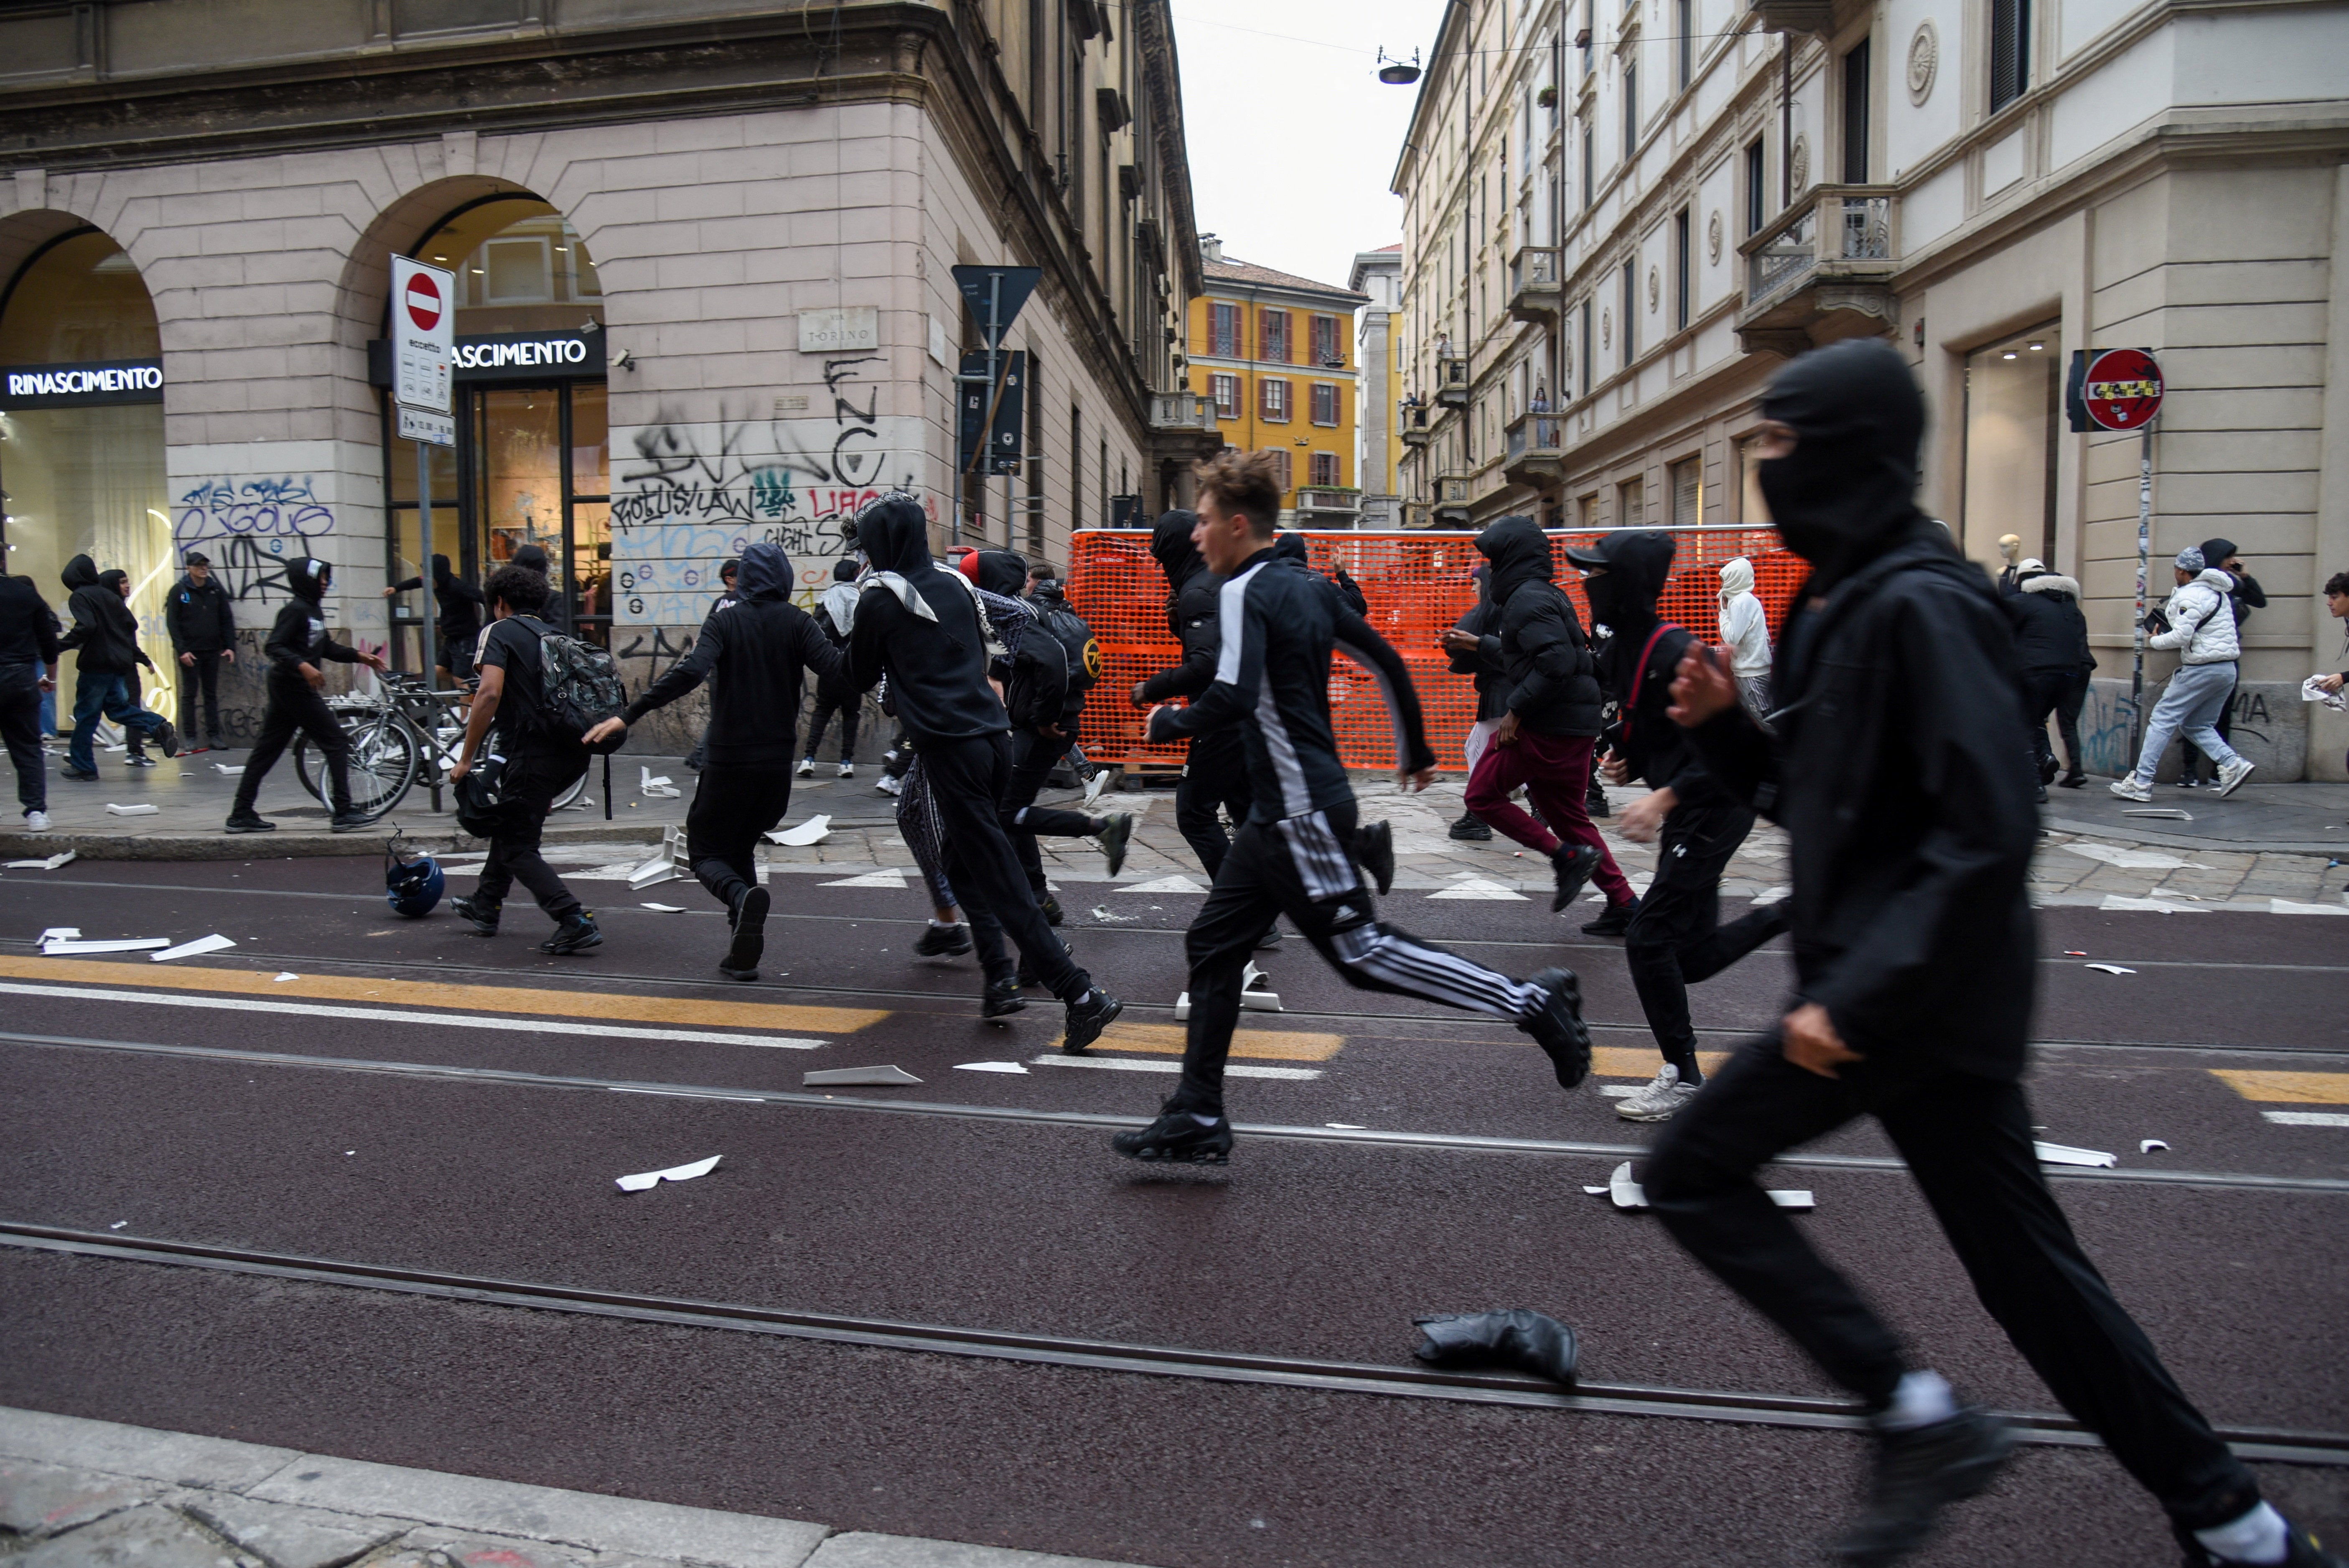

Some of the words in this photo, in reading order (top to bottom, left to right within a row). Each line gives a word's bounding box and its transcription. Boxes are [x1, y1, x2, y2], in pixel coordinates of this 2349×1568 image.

[808, 330, 868, 341] TORINO
[409, 339, 441, 354] eccetto
[8, 367, 163, 395] RINASCIMENTO
